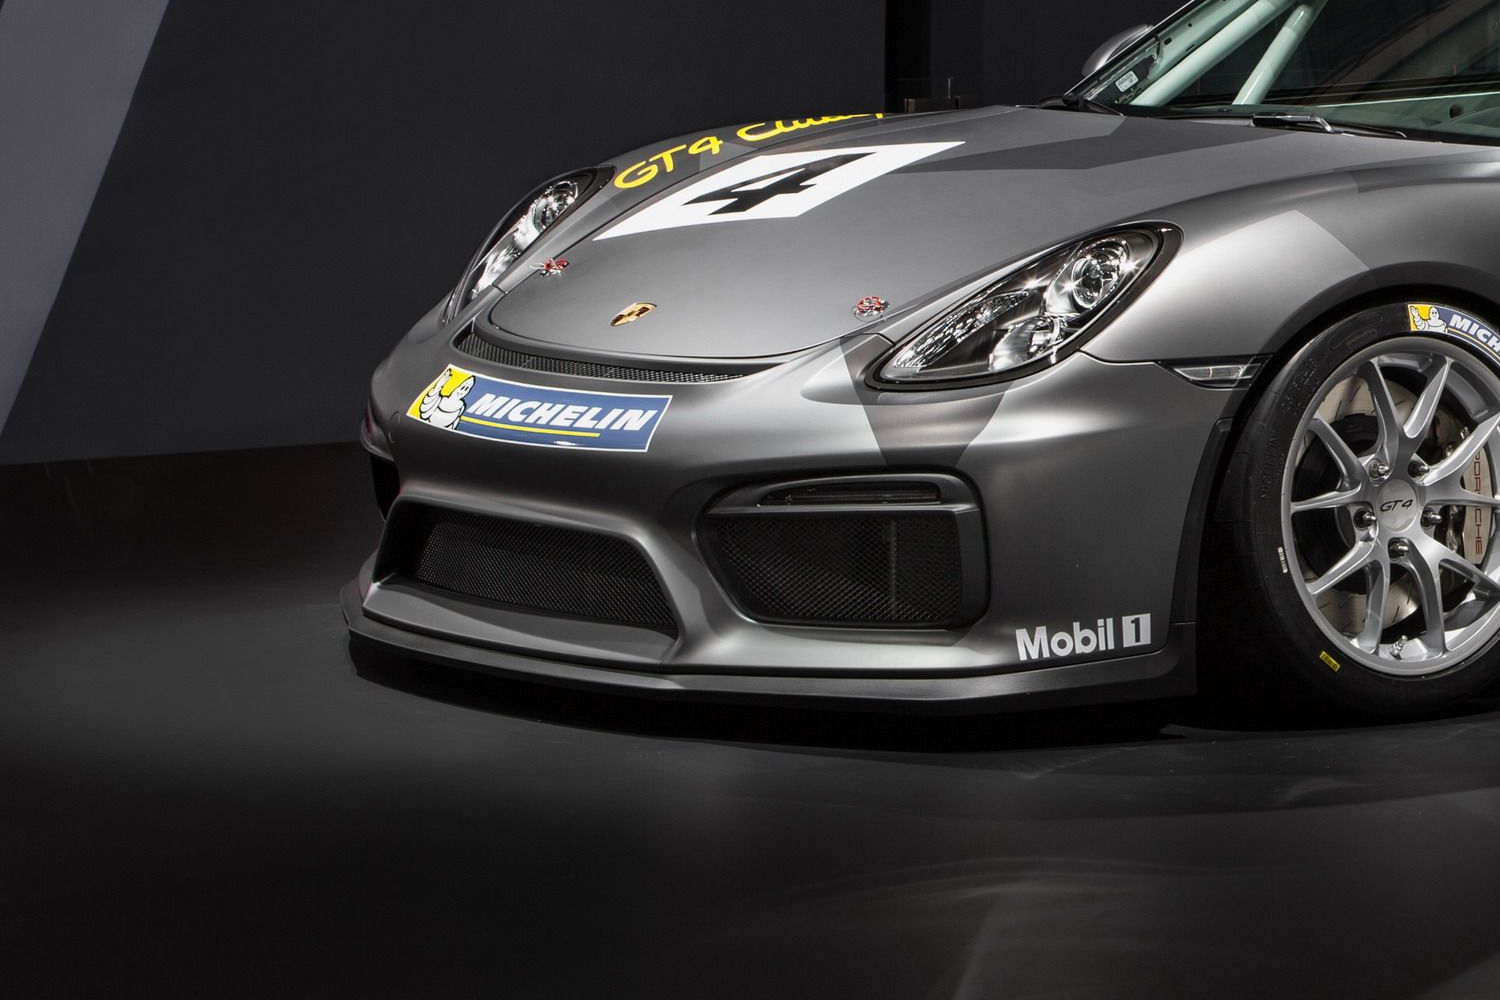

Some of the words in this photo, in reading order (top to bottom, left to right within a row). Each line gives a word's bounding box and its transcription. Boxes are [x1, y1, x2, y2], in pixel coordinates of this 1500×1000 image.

[614, 136, 723, 188] GT4
[681, 152, 878, 216] 4
[467, 393, 658, 431] MICHELIN
[1380, 499, 1413, 512] GT4
[1473, 451, 1483, 554] ORCHE
[1015, 617, 1115, 661] Mobil
